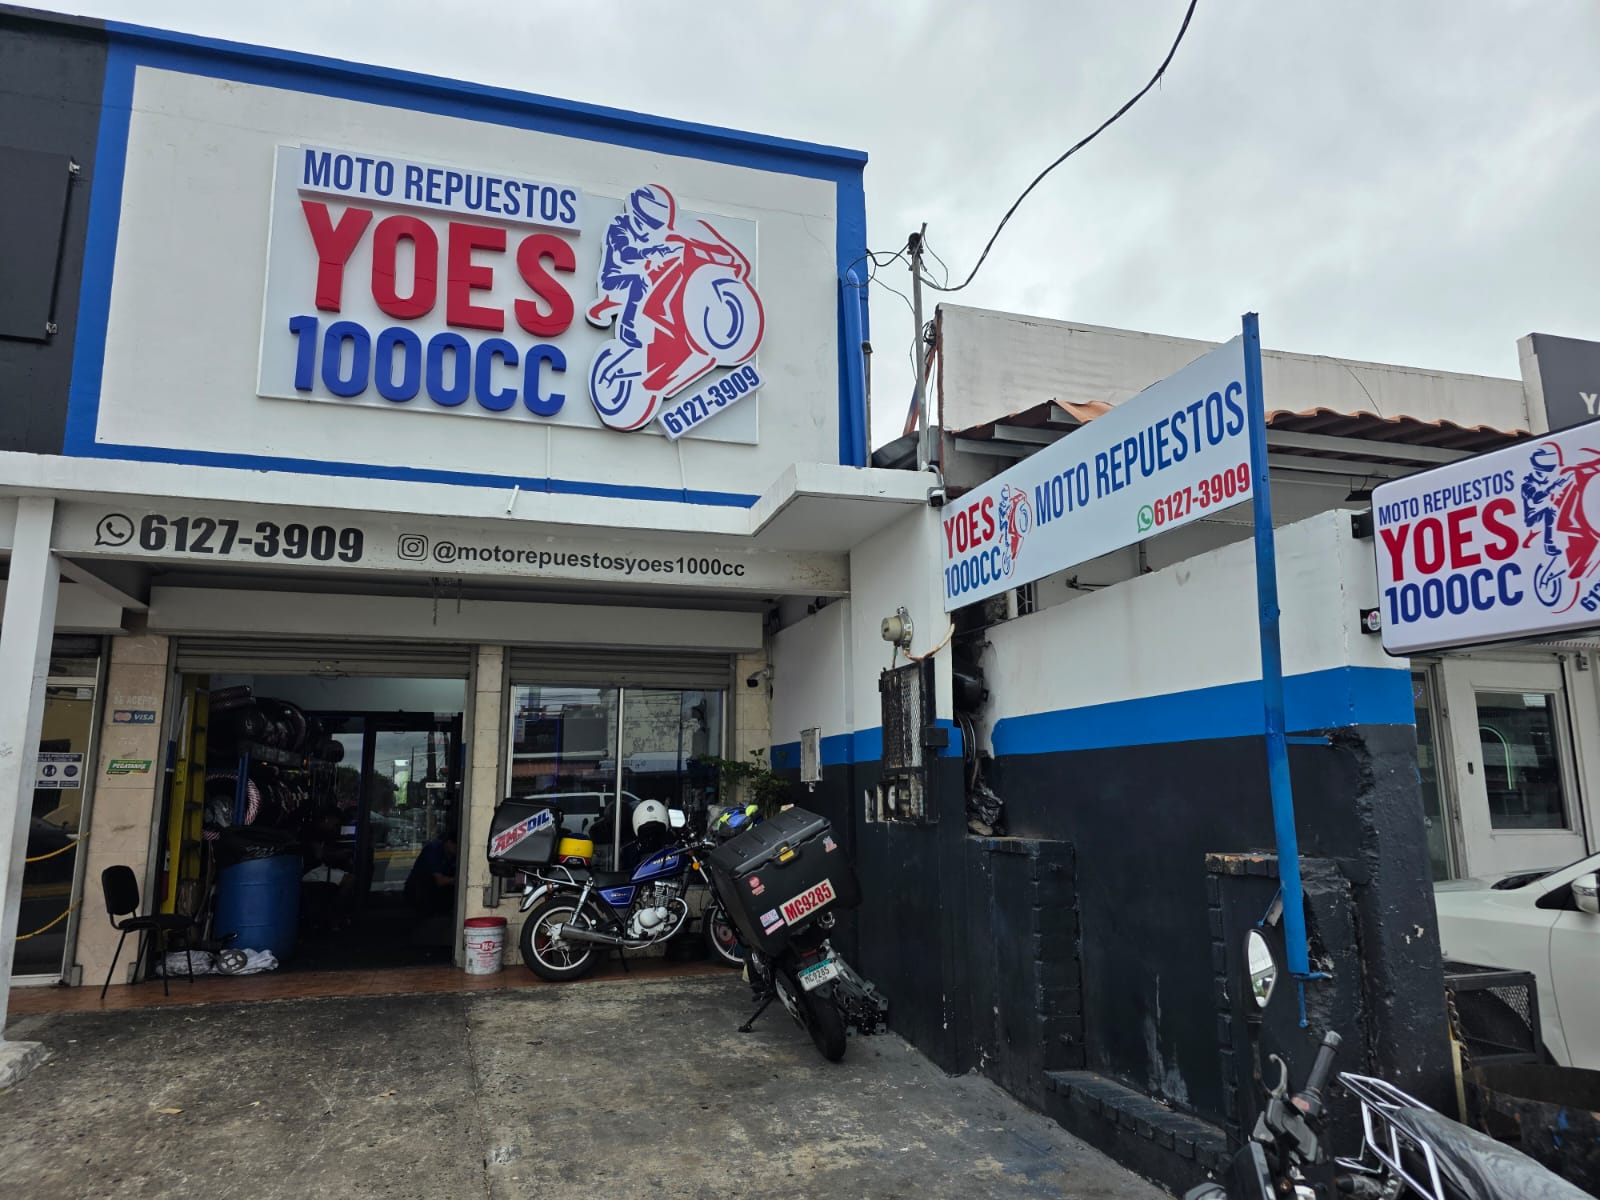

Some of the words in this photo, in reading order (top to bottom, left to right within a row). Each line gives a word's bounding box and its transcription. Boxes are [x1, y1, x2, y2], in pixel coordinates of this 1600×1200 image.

[303, 150, 394, 197] MOTO
[404, 165, 577, 224] REPUESTOS
[301, 200, 577, 337] YOES
[289, 315, 567, 417] 1000CC
[663, 365, 760, 434] 6127-3909
[1579, 391, 1600, 416] Y
[1035, 462, 1090, 527] MOTO
[1095, 381, 1245, 499] REPUESTOS
[1153, 462, 1250, 527] 6127-3909
[1378, 498, 1420, 526] MOTO
[1423, 470, 1515, 514] REPUESTOS
[138, 514, 364, 563] 6127-3909
[943, 495, 995, 559] YOES
[1379, 497, 1519, 582] YOES
[432, 541, 746, 577] @motorepuestosyoes1000cc
[944, 546, 1002, 598] 1000CC
[1384, 562, 1524, 625] 1000CC
[134, 713, 154, 721] VISA
[493, 811, 550, 853] AMSOIL
[784, 883, 832, 922] MC9285
[804, 966, 830, 984] MC9285
